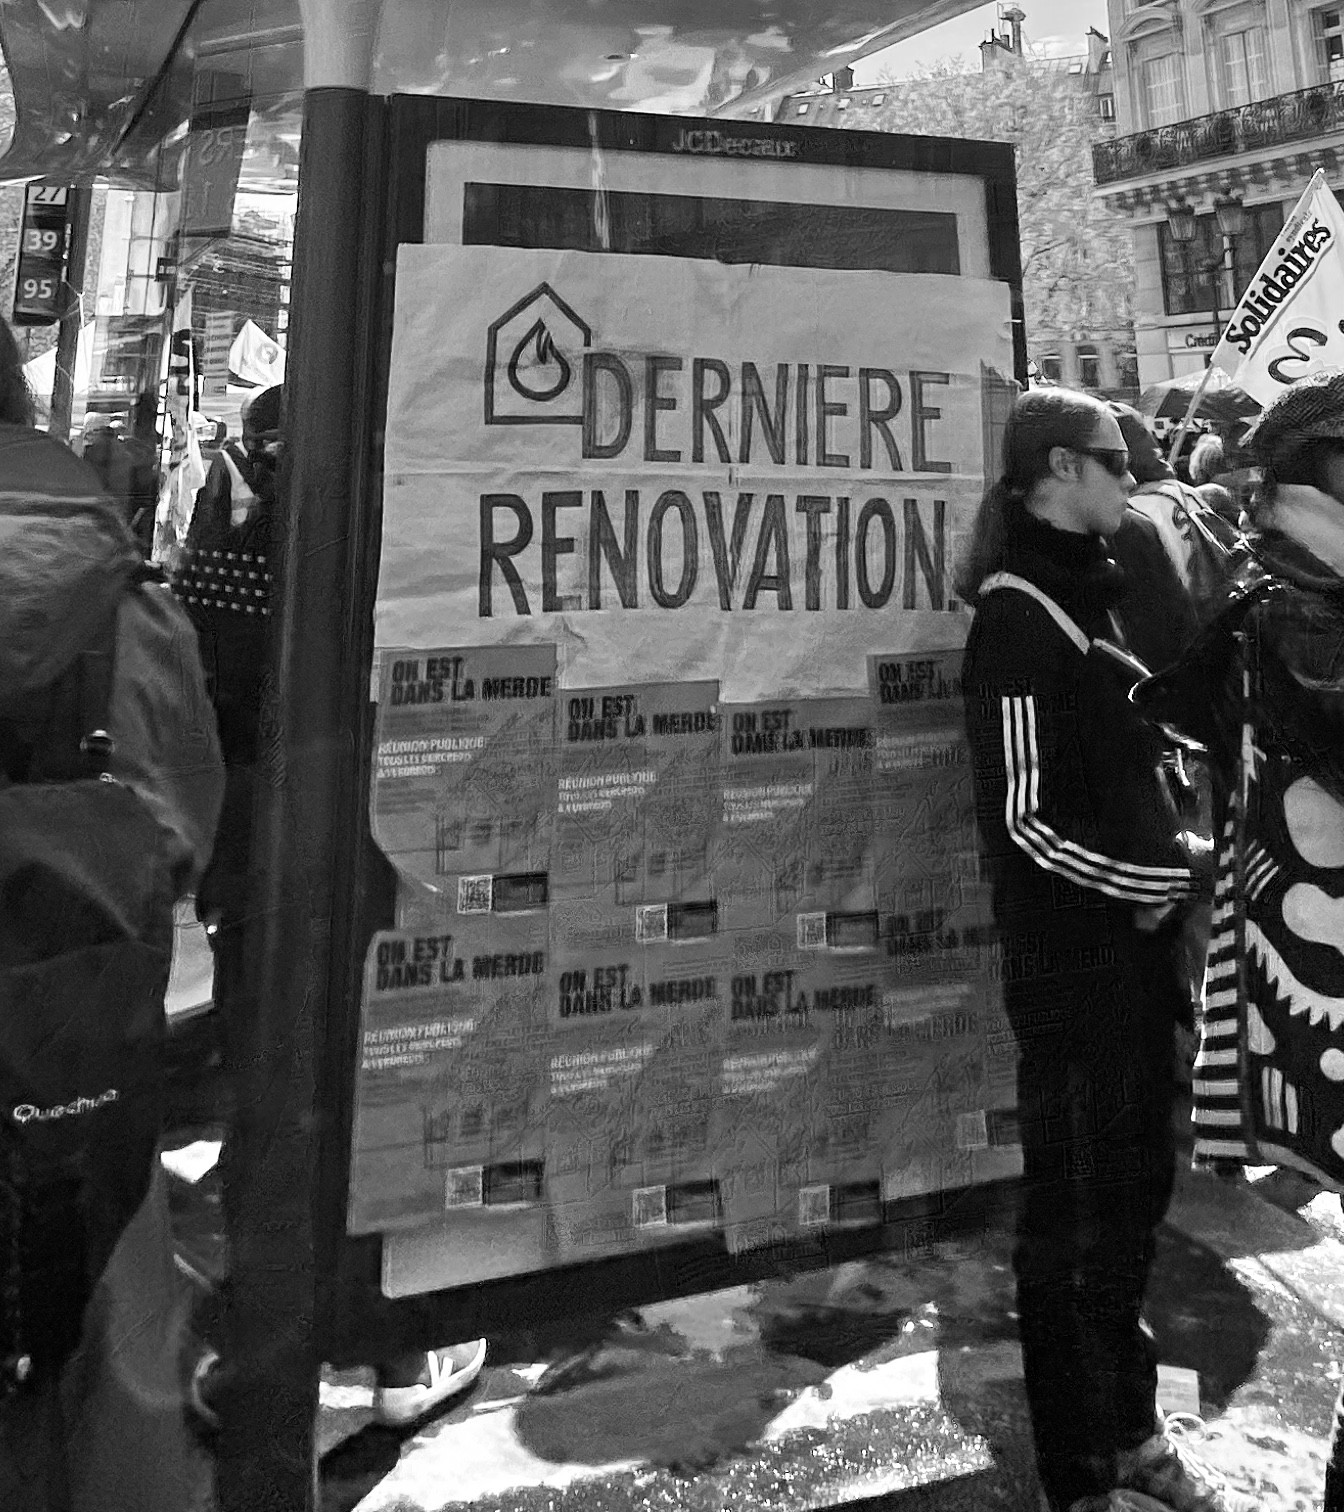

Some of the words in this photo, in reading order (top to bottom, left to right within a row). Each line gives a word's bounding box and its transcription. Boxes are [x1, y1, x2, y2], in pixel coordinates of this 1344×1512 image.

[27, 231, 57, 251] 39
[23, 279, 52, 299] 95
[1225, 218, 1332, 355] Solidaires
[580, 352, 954, 474] DERNIERE
[392, 660, 419, 682] ON
[426, 656, 464, 681] EST
[390, 681, 444, 705] DANS
[450, 680, 476, 701] LA
[481, 676, 552, 701] MERDE
[568, 697, 594, 721] ON
[601, 694, 635, 718] EST
[567, 718, 618, 743] DANS
[624, 715, 646, 737] LA
[377, 941, 405, 966] ON
[413, 935, 453, 962] EST
[376, 963, 433, 990] DANS
[439, 958, 465, 983] LA
[559, 970, 587, 994] ON
[593, 964, 630, 990] EST
[558, 988, 612, 1018] DANS
[619, 984, 643, 1011] LA
